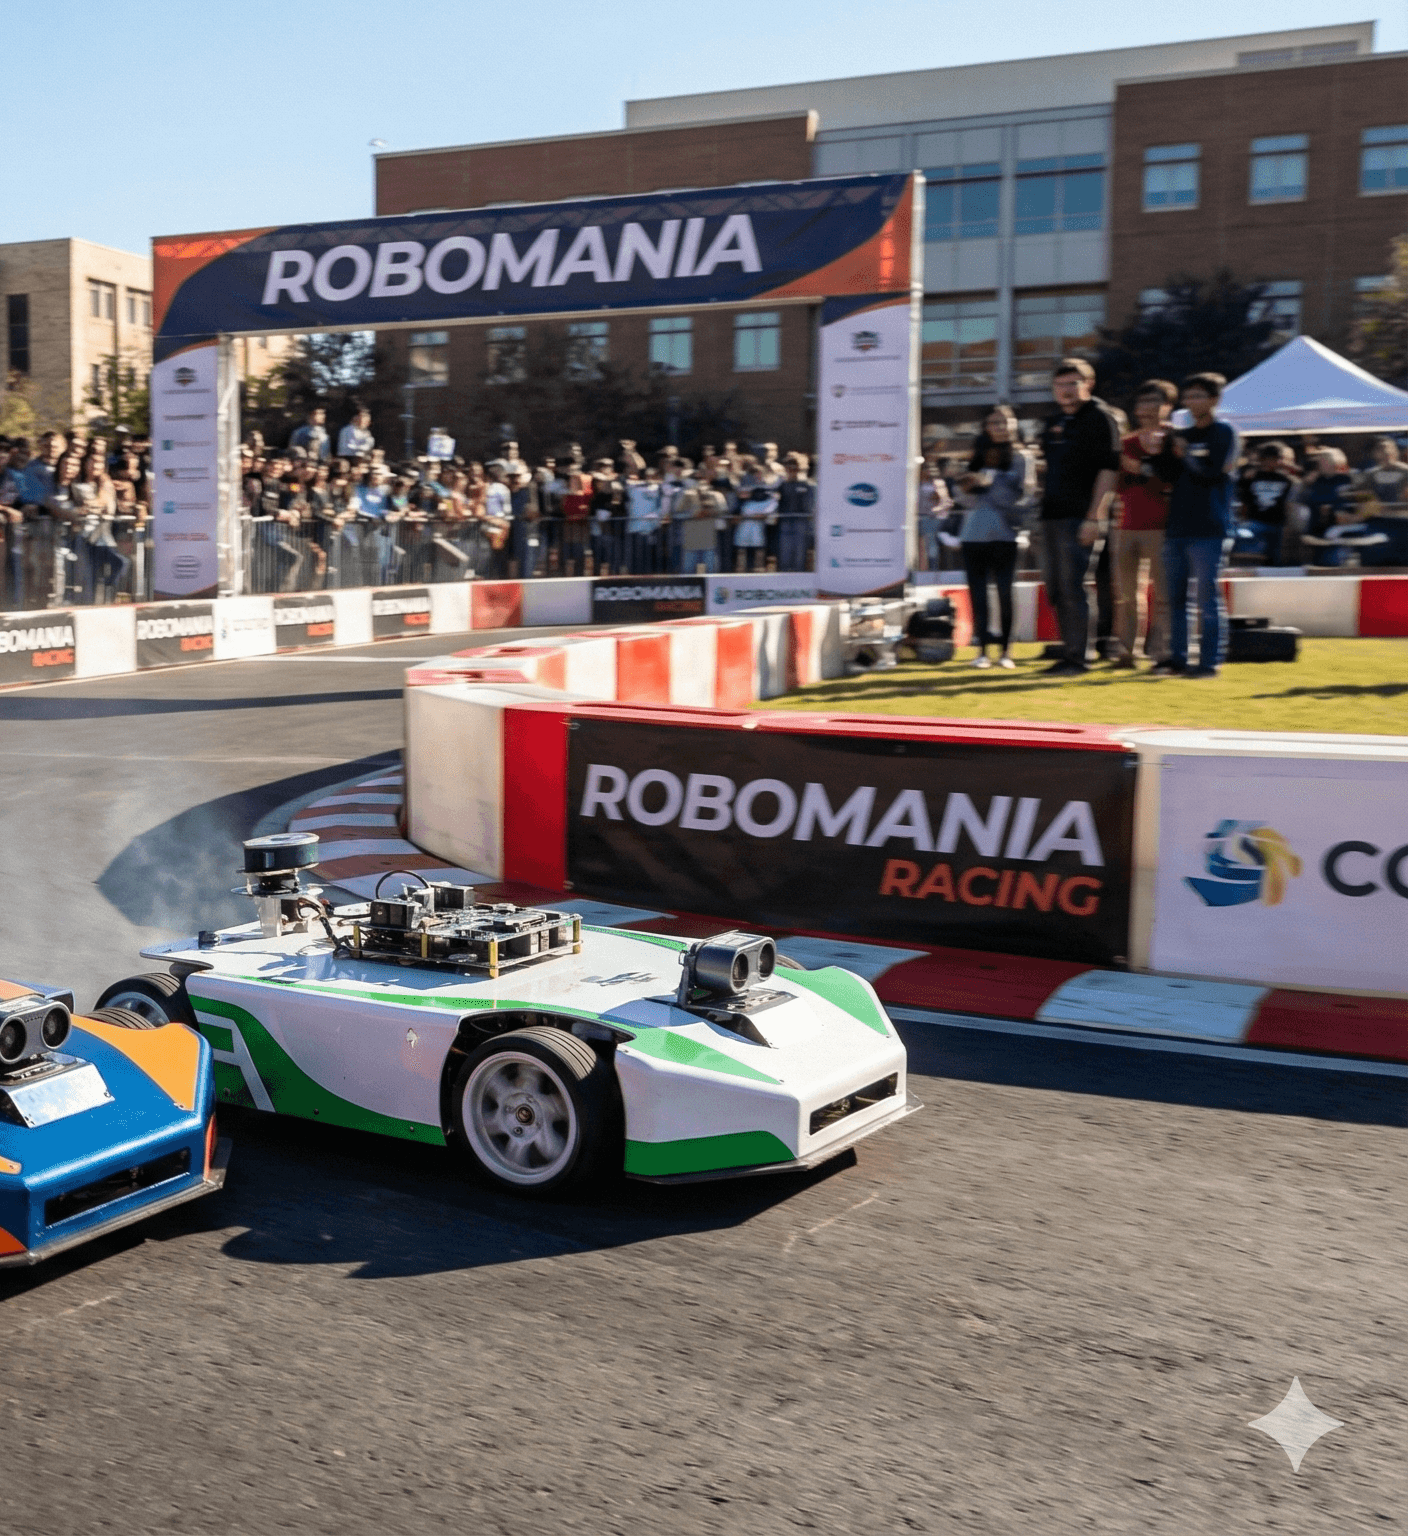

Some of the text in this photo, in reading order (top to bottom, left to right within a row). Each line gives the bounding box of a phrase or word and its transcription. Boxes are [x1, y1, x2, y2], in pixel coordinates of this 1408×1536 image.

[261, 214, 762, 305] ROBOMANIA
[580, 763, 1105, 867] ROBOMANIA
[879, 858, 1104, 917] RACING
